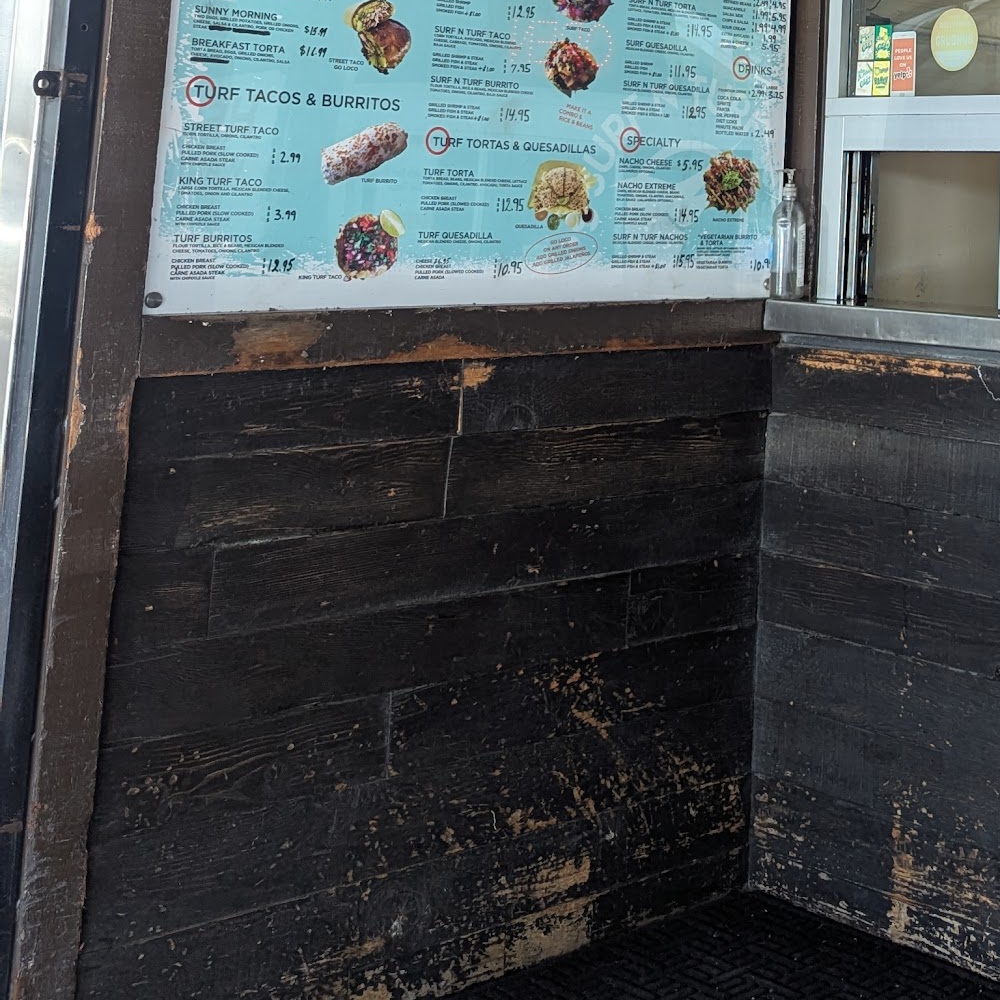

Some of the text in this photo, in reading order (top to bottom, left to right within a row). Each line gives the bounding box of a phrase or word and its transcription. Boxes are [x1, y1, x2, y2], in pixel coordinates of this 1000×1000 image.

[648, 0, 653, 7] N
[654, 0, 673, 9] TURF
[674, 2, 695, 10] TORTA
[194, 5, 277, 20] SUNNY MORNING
[434, 25, 456, 36] SURF
[466, 28, 486, 36] TURF
[489, 31, 510, 40] TACO
[191, 37, 284, 53] BREAKFAST TORTA
[625, 39, 687, 51] SURF QUESADILLA
[738, 63, 773, 75] DRINKS
[430, 75, 452, 85] SURF
[484, 80, 519, 89] BURRITO
[622, 80, 640, 89] SURF
[643, 82, 648, 90] N
[650, 82, 667, 91] TURF
[669, 84, 709, 93] QUESADILLA
[191, 84, 399, 110] TURF TACOS & BURRITOS
[182, 122, 278, 135] STREET TURF TACO
[433, 135, 595, 153] TURF TORTAS & QUESADILLAS
[626, 135, 680, 147] SPECIALTY
[618, 157, 672, 166] NACHO CHEESE
[423, 168, 444, 177] TURF
[178, 176, 262, 187] KING TURF TACO
[617, 182, 675, 191] NACHO EXTREME
[173, 234, 253, 244] TURF BURRITOS
[418, 231, 494, 240] TURF QUESADILLA
